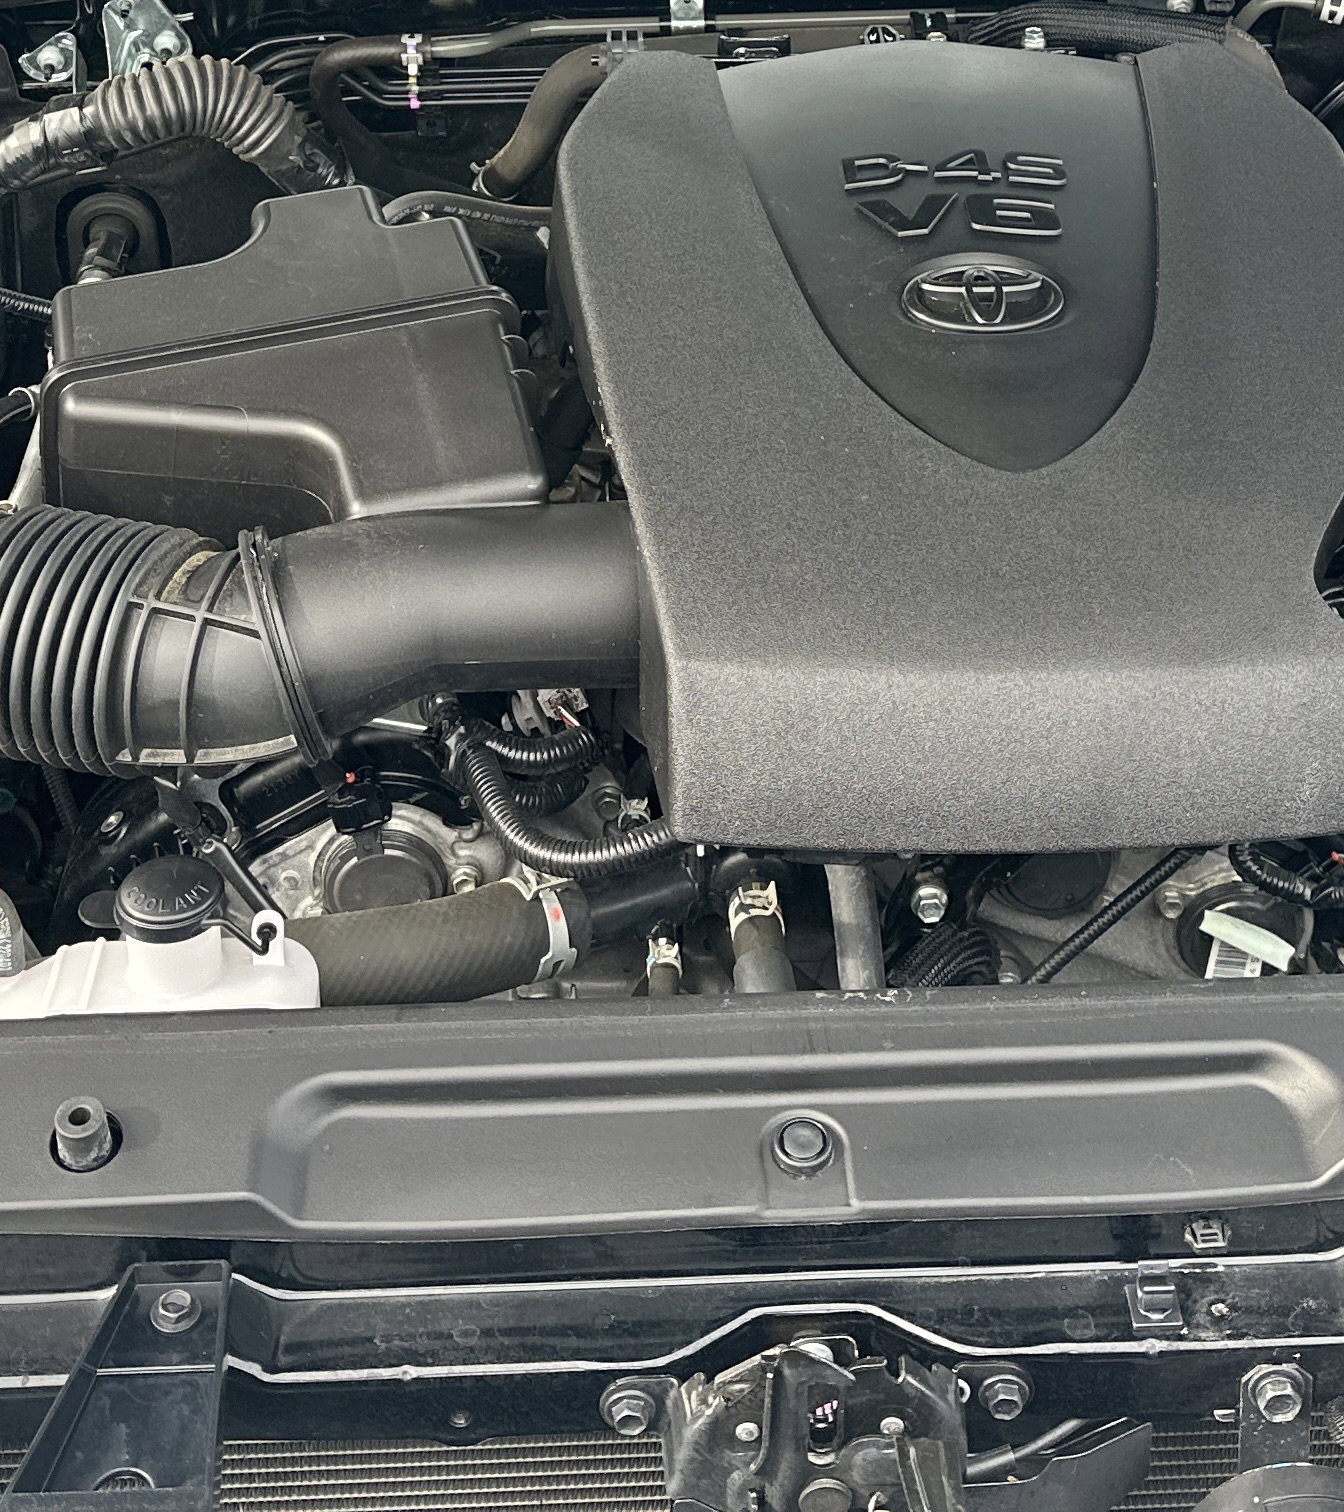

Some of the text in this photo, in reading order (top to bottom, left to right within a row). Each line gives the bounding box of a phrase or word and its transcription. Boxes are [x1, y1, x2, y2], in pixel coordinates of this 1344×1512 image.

[841, 149, 1067, 190] D-4S
[856, 192, 1063, 237] V6
[127, 881, 210, 914] COOLANT
